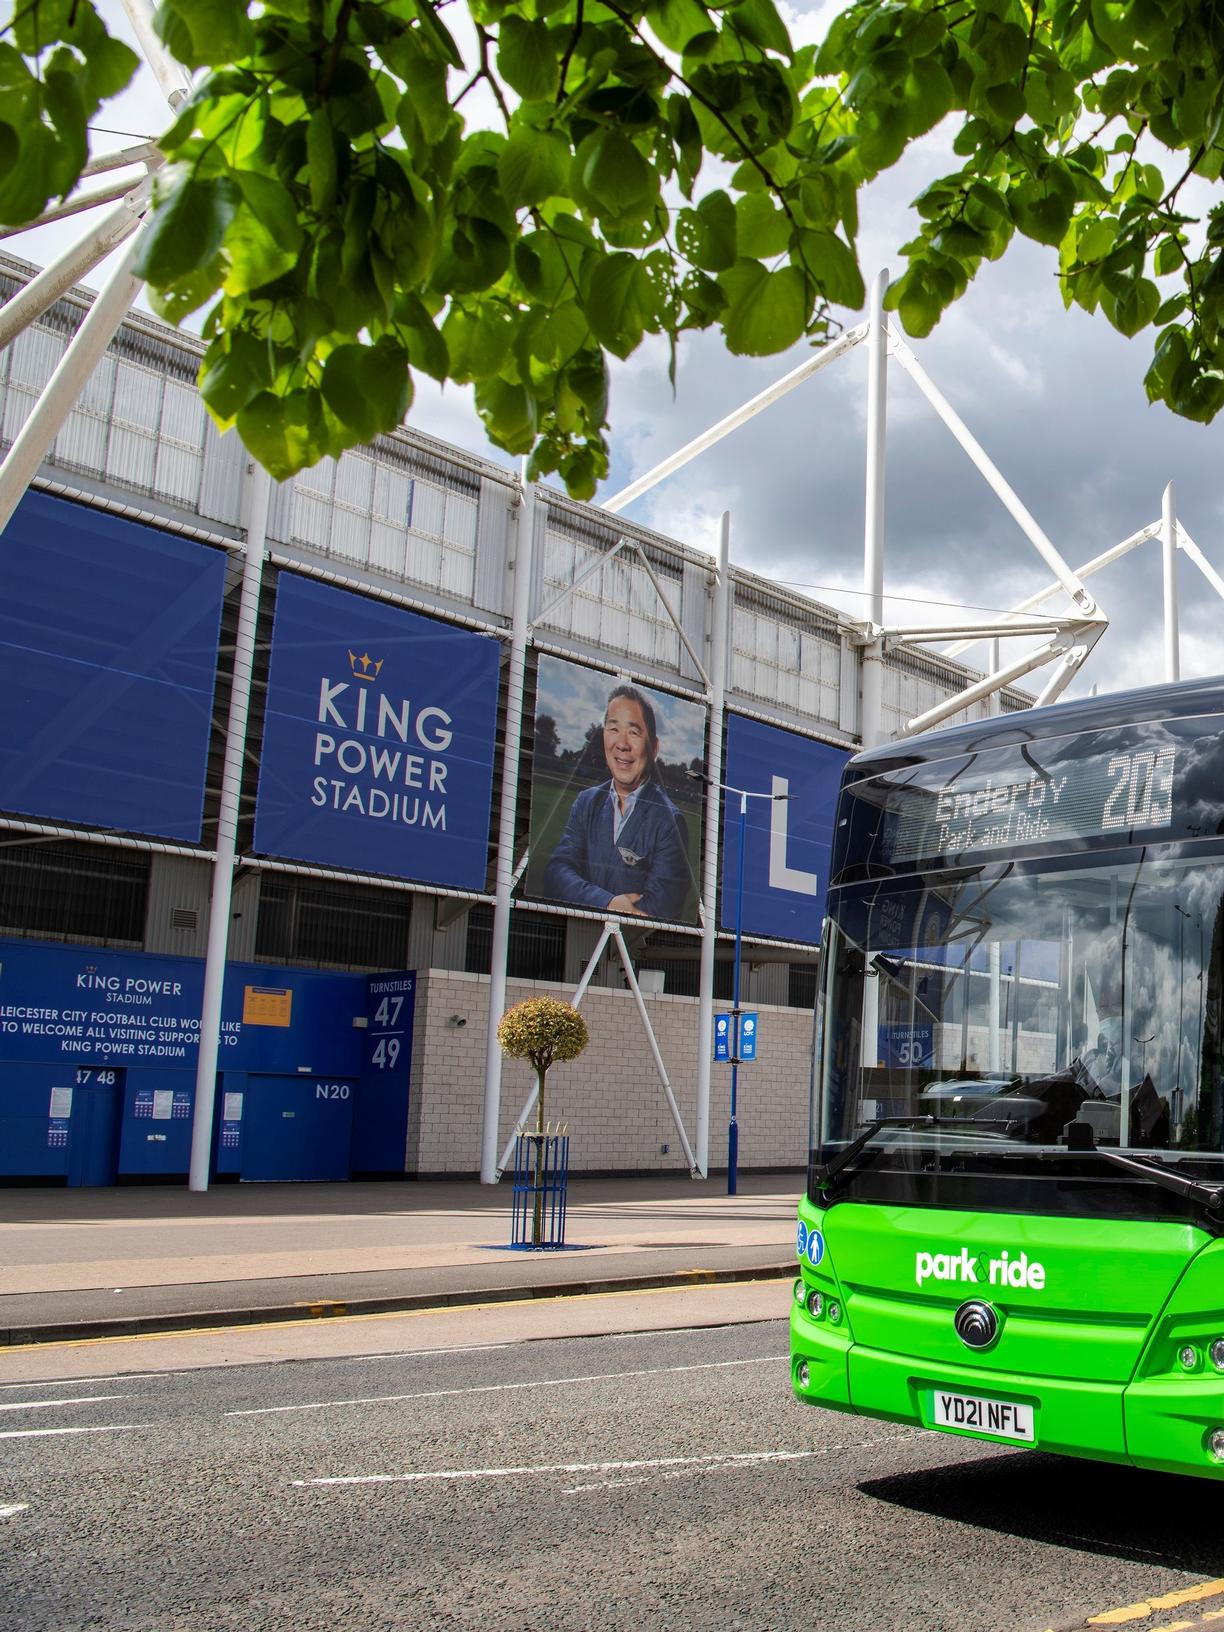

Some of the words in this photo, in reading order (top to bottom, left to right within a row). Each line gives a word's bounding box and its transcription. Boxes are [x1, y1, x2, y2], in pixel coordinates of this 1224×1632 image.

[318, 677, 453, 752] KING
[314, 733, 448, 794] POWER
[936, 770, 1068, 822] Enderby
[1101, 744, 1176, 829] 203
[311, 776, 447, 831] STADIUM
[768, 774, 818, 897] L
[938, 820, 976, 852] Park
[981, 813, 1012, 846] and
[1016, 808, 1050, 842] Ride
[76, 973, 121, 991] KING
[125, 978, 182, 996] POWER
[370, 979, 412, 994] TURNSTILES
[106, 992, 152, 1005] STADIUM
[374, 996, 405, 1027] 47
[0, 1006, 59, 1021] LEICESTER
[62, 1010, 88, 1022] CITY
[91, 1012, 147, 1027] FOOTBALL
[150, 1016, 177, 1029] CLUB
[221, 1021, 241, 1033] LIKE
[2, 1021, 18, 1033] TO
[22, 1022, 83, 1037] WELCOME
[86, 1026, 106, 1038] ALL
[109, 1028, 156, 1041] VISITING
[224, 1035, 238, 1046] TO
[891, 1030, 929, 1040] TURNSTILES
[61, 1040, 92, 1052] KING
[95, 1043, 135, 1055] POWER
[138, 1045, 186, 1057] STADIUM
[371, 1038, 401, 1069] 49
[898, 1041, 923, 1064] 50
[97, 1070, 116, 1085] 48
[316, 1084, 350, 1100] N20
[941, 1395, 983, 1426] YD21
[988, 1403, 1026, 1434] NFL
